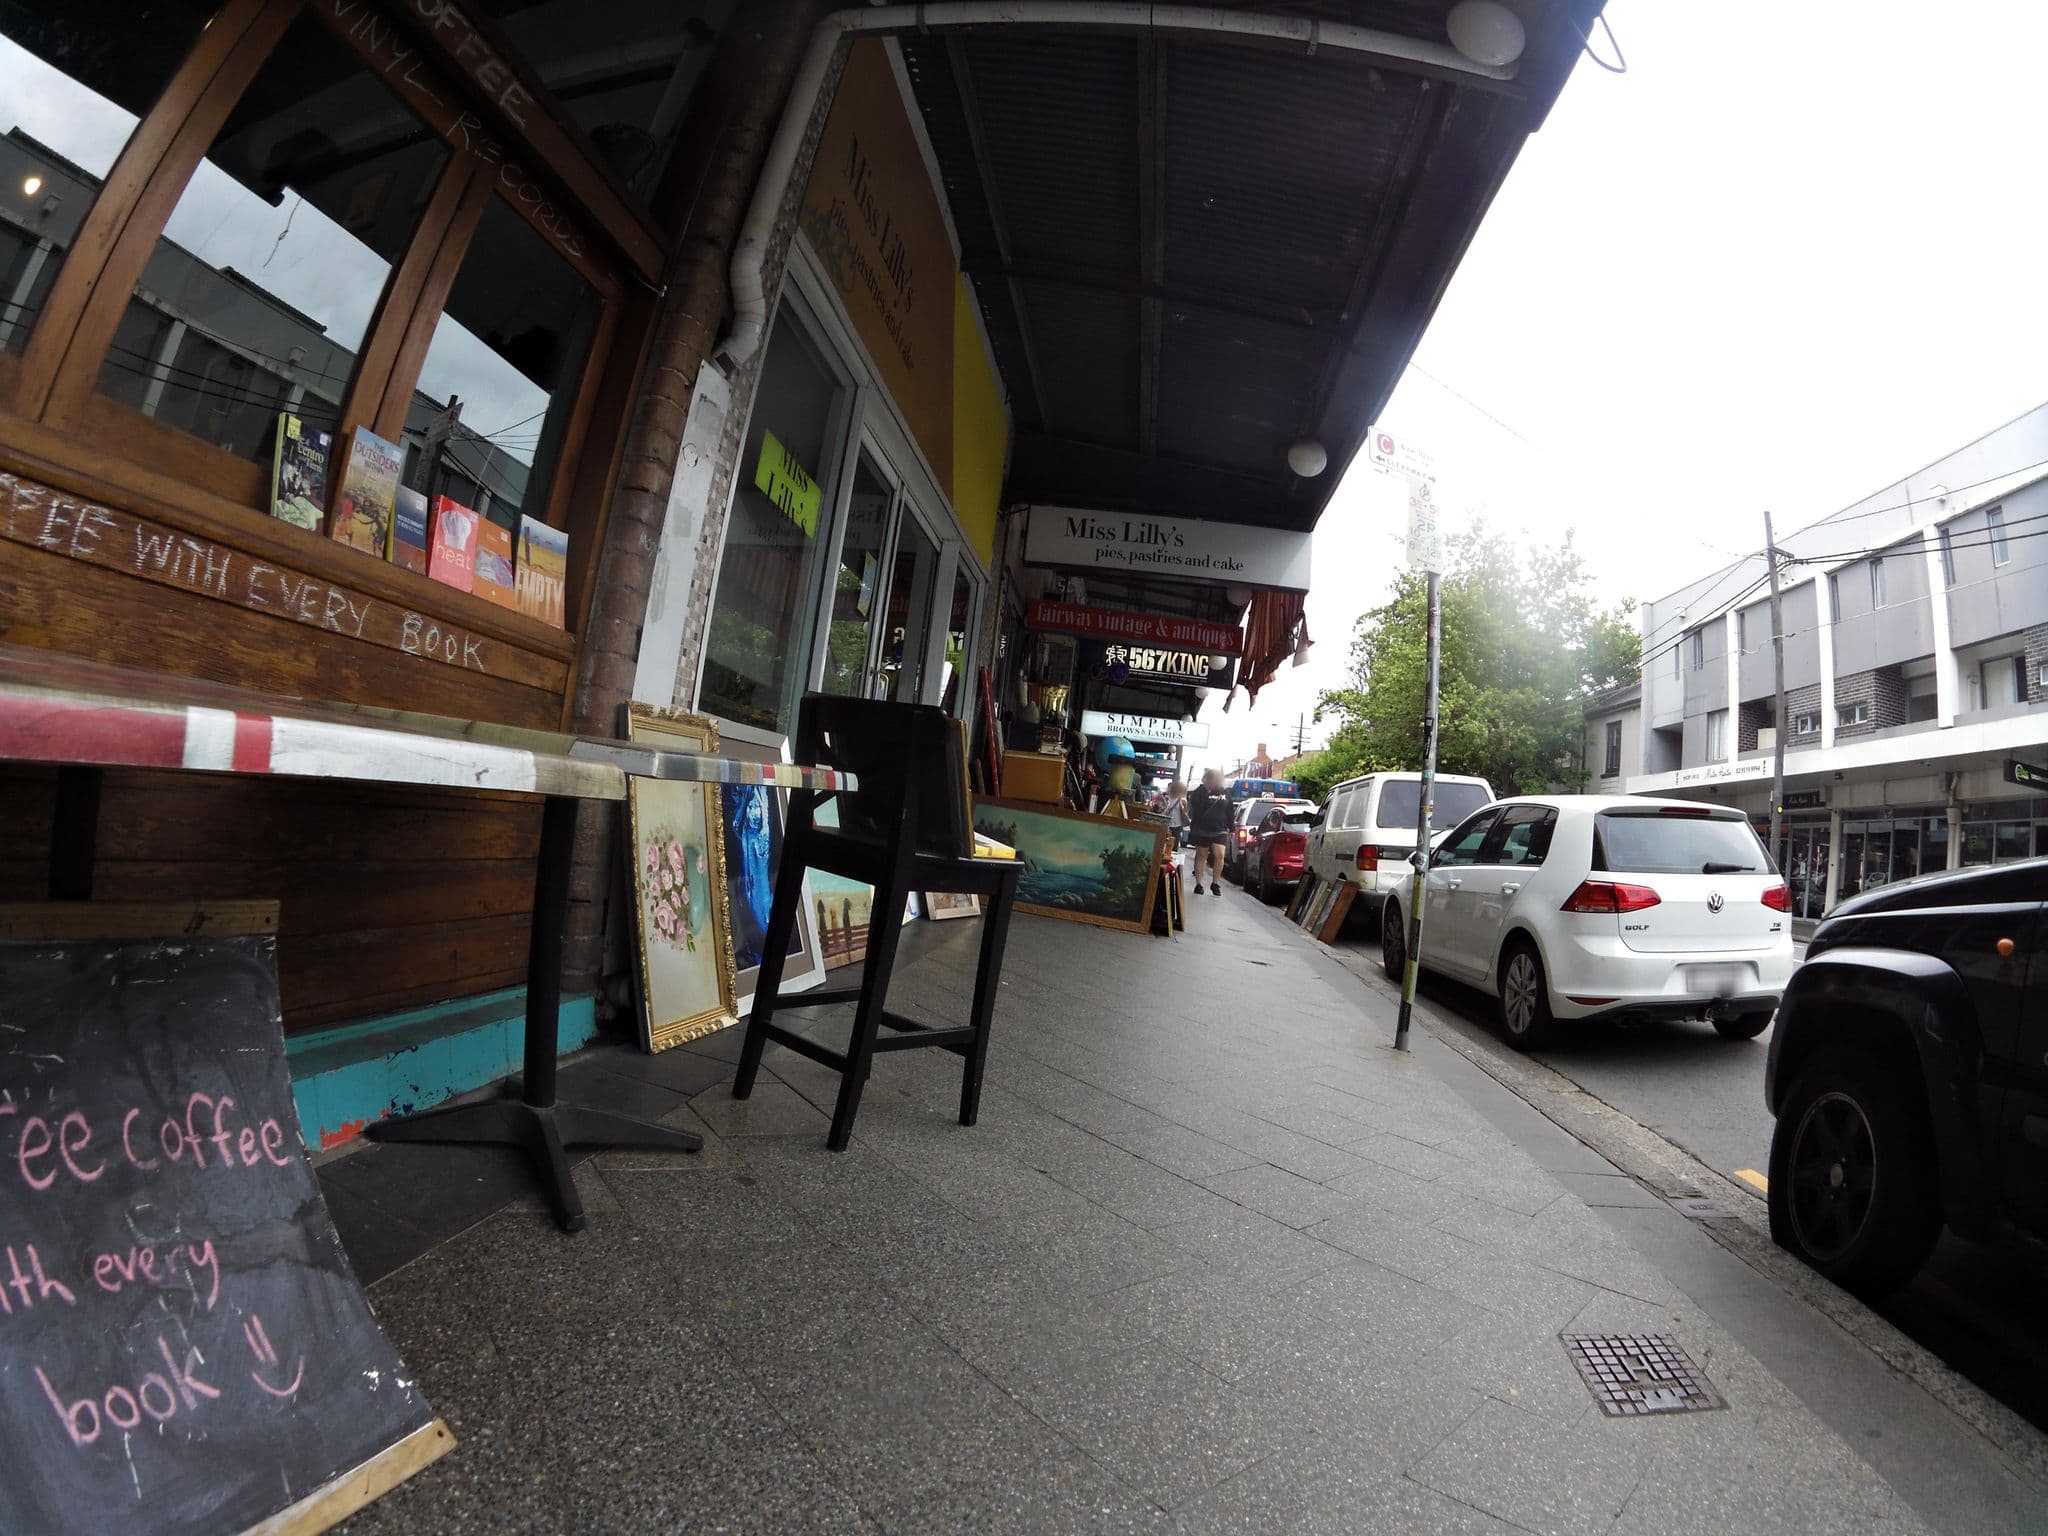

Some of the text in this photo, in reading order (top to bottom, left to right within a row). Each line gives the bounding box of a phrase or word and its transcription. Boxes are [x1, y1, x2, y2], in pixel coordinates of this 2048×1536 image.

[354, 442, 400, 474] OUTSIDERS
[1064, 516, 1184, 553] Miss Lilly's
[434, 540, 471, 571] heat
[1095, 545, 1244, 571] pies, pastries and cake
[134, 523, 233, 596] WITH
[247, 564, 372, 638] EVERY
[401, 608, 486, 673] BOOK
[515, 567, 564, 606] EMPTY
[1037, 604, 1234, 649] fairway vintage & antiques
[1129, 647, 1209, 677] 567KING
[1107, 712, 1186, 731] SIMPLY
[1107, 725, 1140, 736] BROWS
[1147, 729, 1184, 740] LASHES
[94, 1239, 220, 1312] every
[34, 1335, 221, 1448] book
